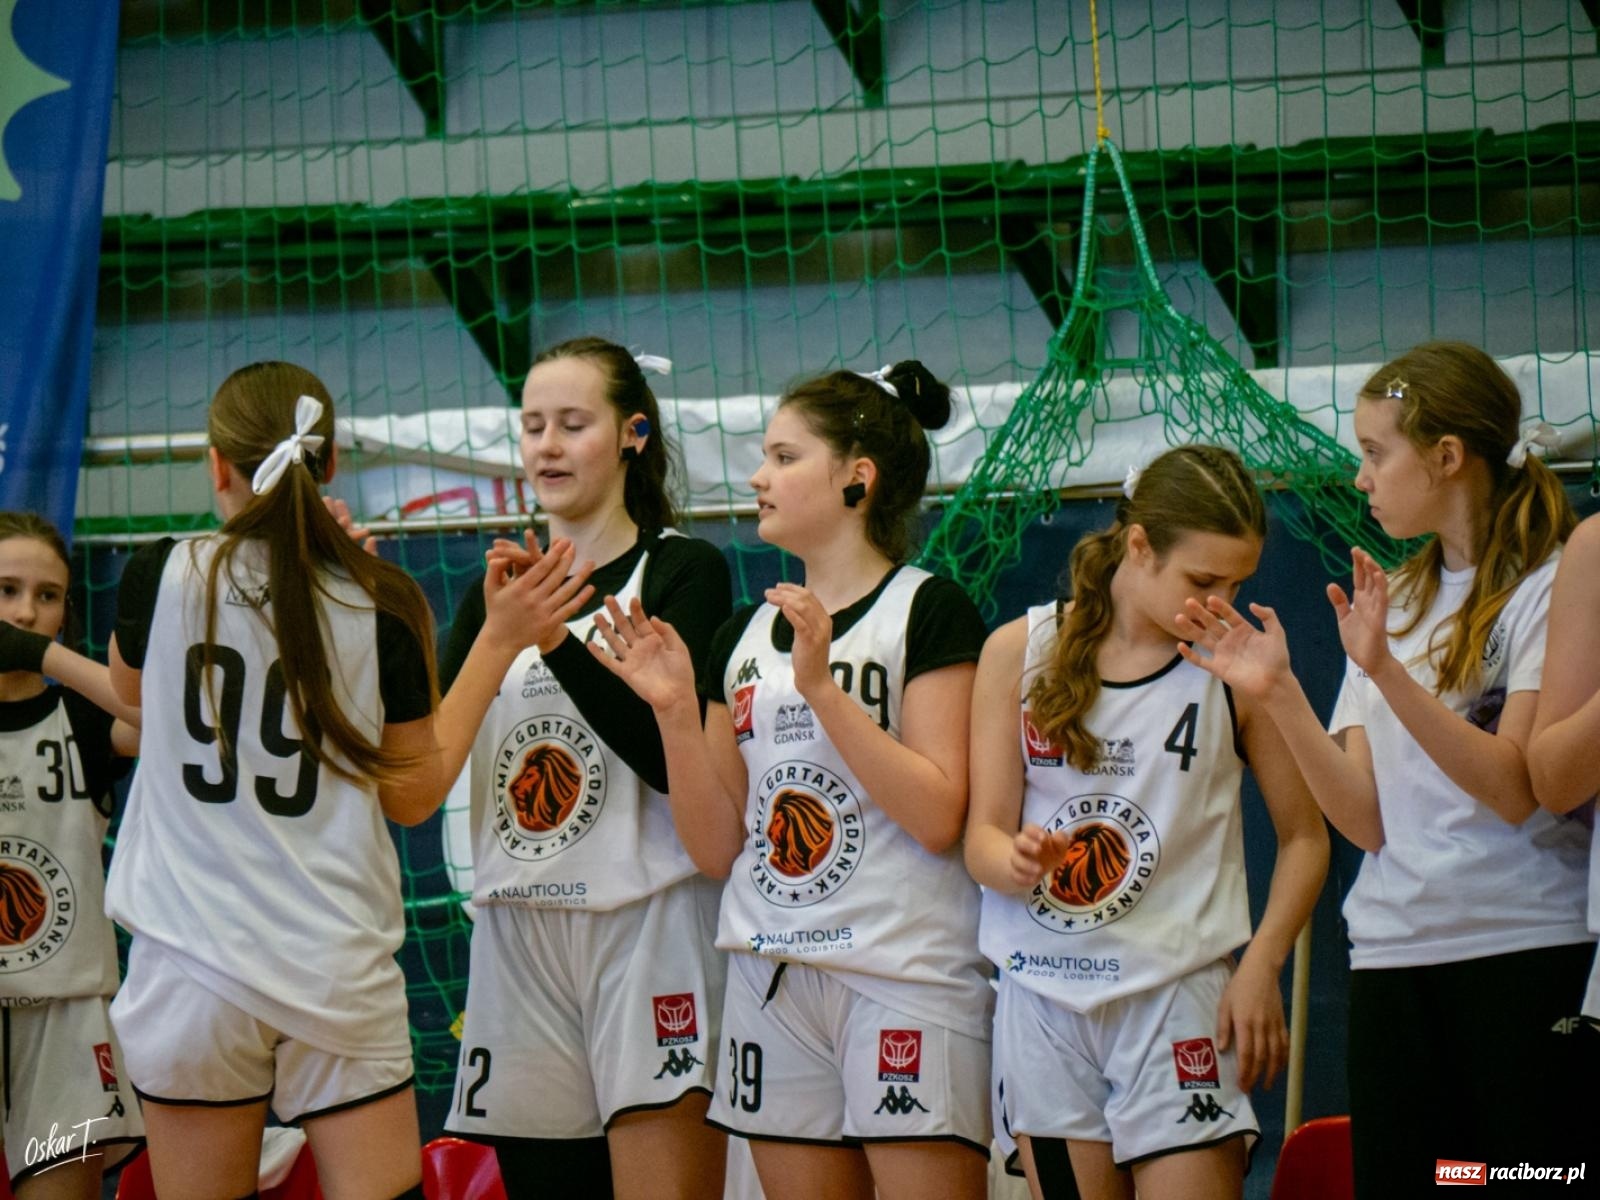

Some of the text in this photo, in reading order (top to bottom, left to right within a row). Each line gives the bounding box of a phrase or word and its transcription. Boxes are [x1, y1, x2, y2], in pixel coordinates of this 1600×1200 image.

[183, 642, 323, 818] 99
[1164, 703, 1199, 771] 4
[515, 721, 594, 757] GORTATA
[558, 764, 602, 845] GDAŃSK
[766, 766, 847, 805] GORTATA
[814, 813, 860, 894] GDAŃSK
[1068, 800, 1151, 843] GORTATA
[502, 882, 587, 899] NAUTIOUS
[1093, 852, 1154, 923] GDAŃSK
[26, 887, 71, 962] GDAŃSK
[766, 927, 852, 945] NAUTIOUS
[1029, 955, 1120, 972] NAUTIOUS
[1551, 1016, 1580, 1034] 4F
